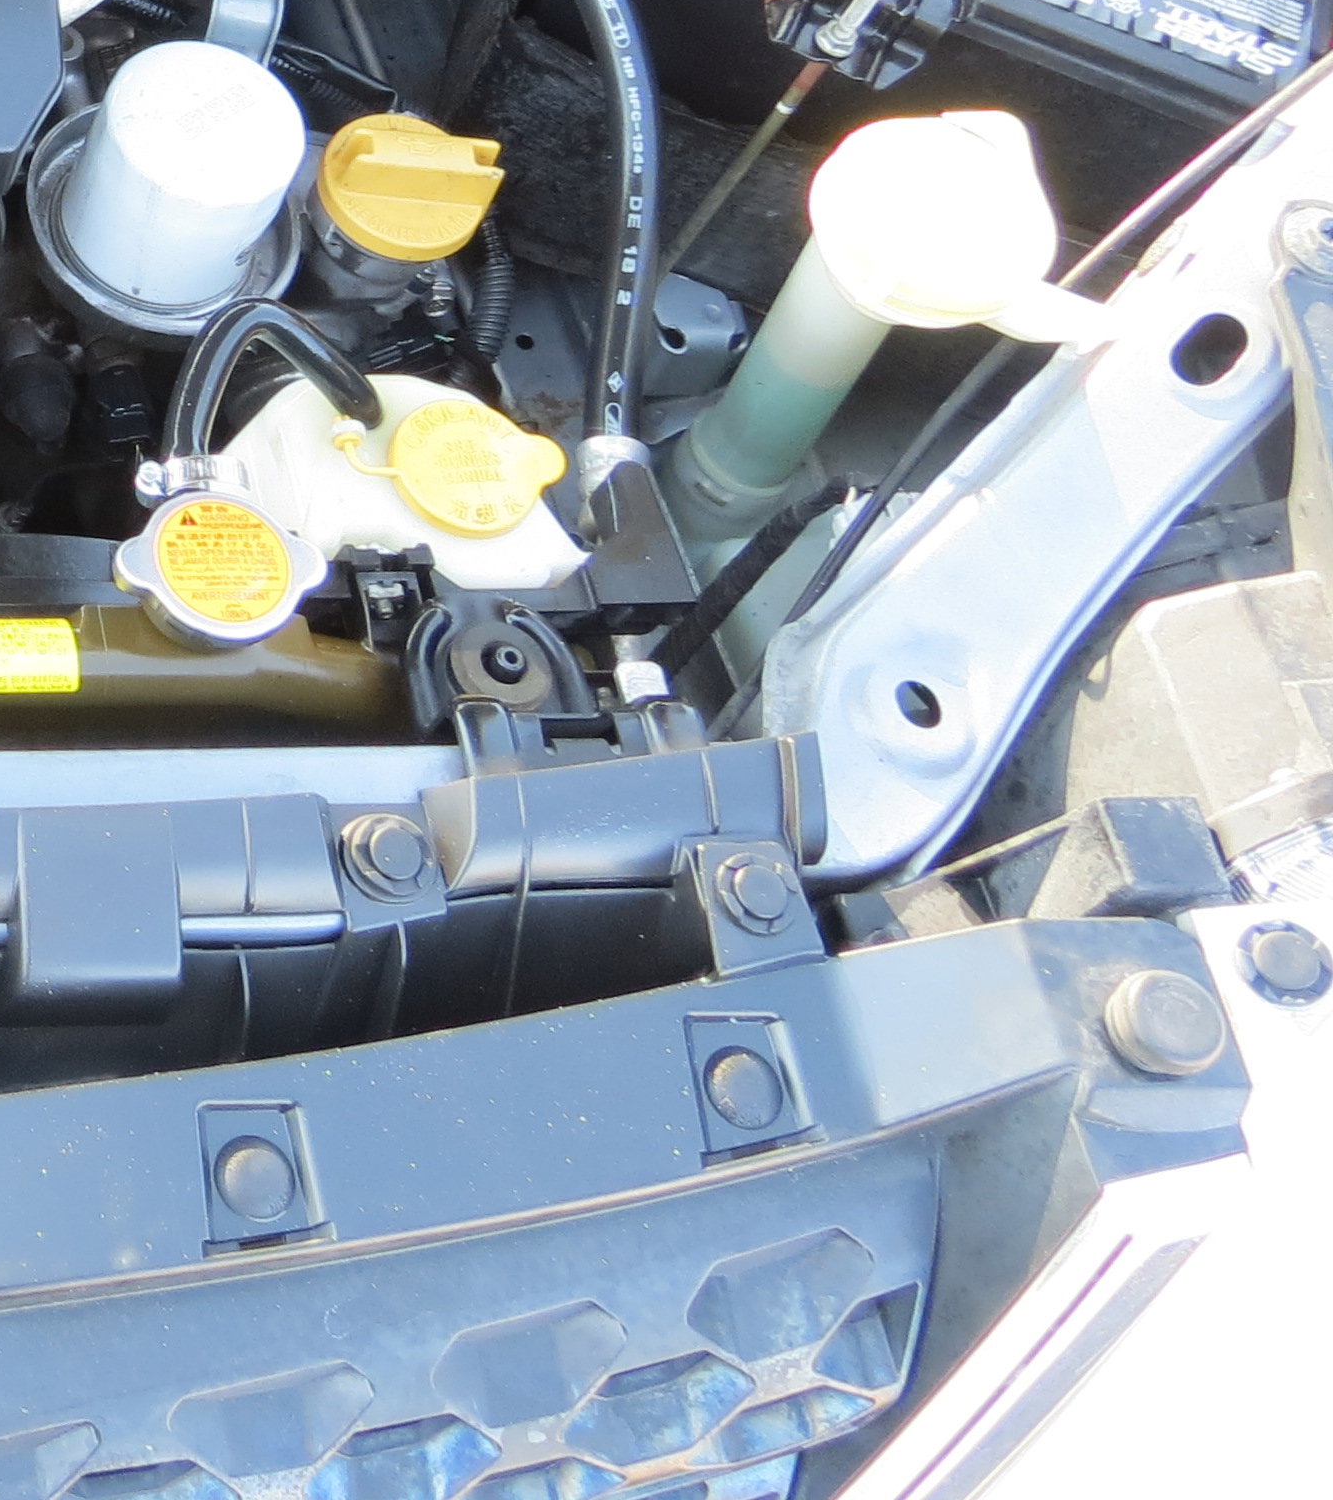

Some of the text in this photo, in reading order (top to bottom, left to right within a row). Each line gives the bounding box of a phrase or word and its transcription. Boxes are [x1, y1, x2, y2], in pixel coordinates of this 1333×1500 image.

[1154, 14, 1276, 76] SUPER
[1156, 2, 1299, 68] START
[621, 56, 636, 79] HP
[627, 195, 644, 229] DE
[620, 246, 638, 274] 18
[615, 289, 631, 306] 2
[191, 592, 270, 601] AVERTISSEMENT
